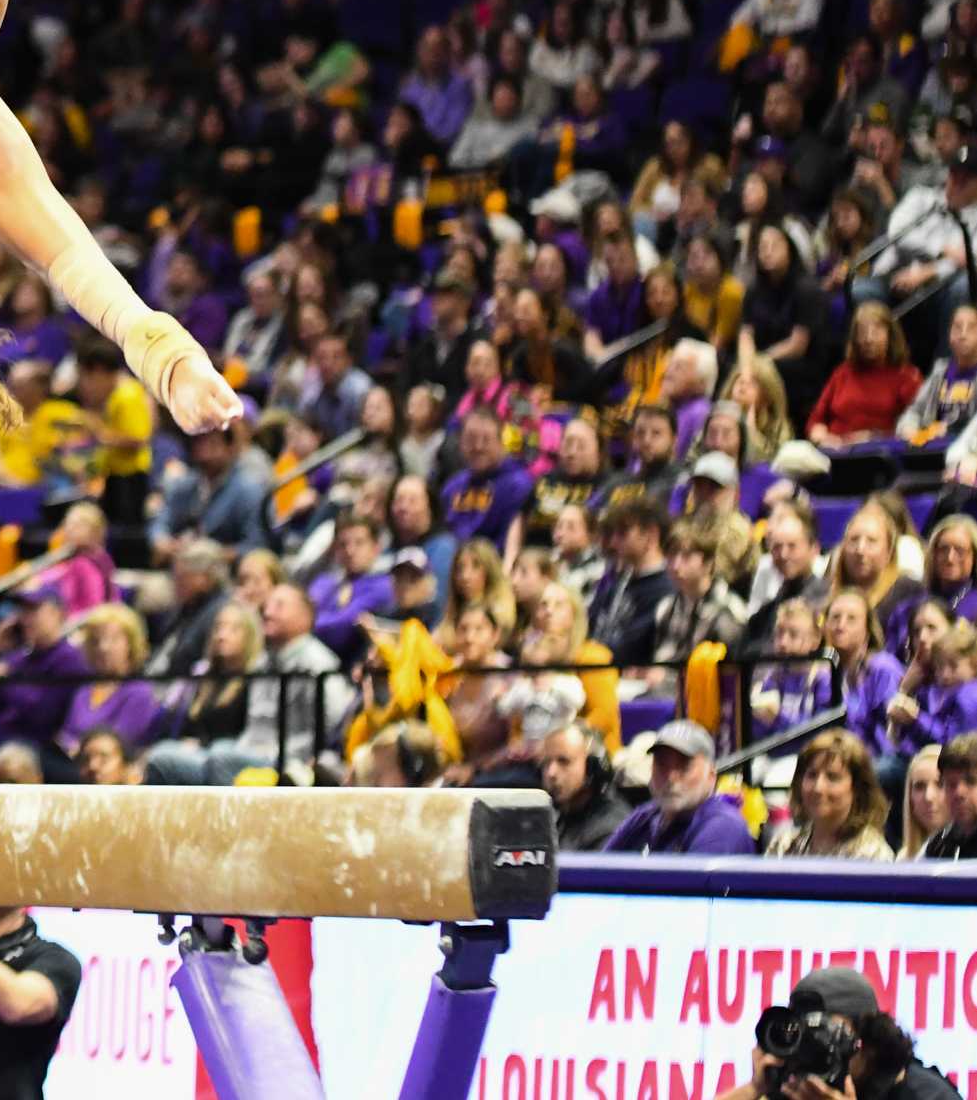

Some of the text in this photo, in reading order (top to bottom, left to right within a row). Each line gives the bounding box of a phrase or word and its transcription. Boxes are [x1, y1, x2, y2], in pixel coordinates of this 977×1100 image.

[58, 956, 177, 1065] OUGE
[588, 947, 977, 1030] AN AUTNTI
